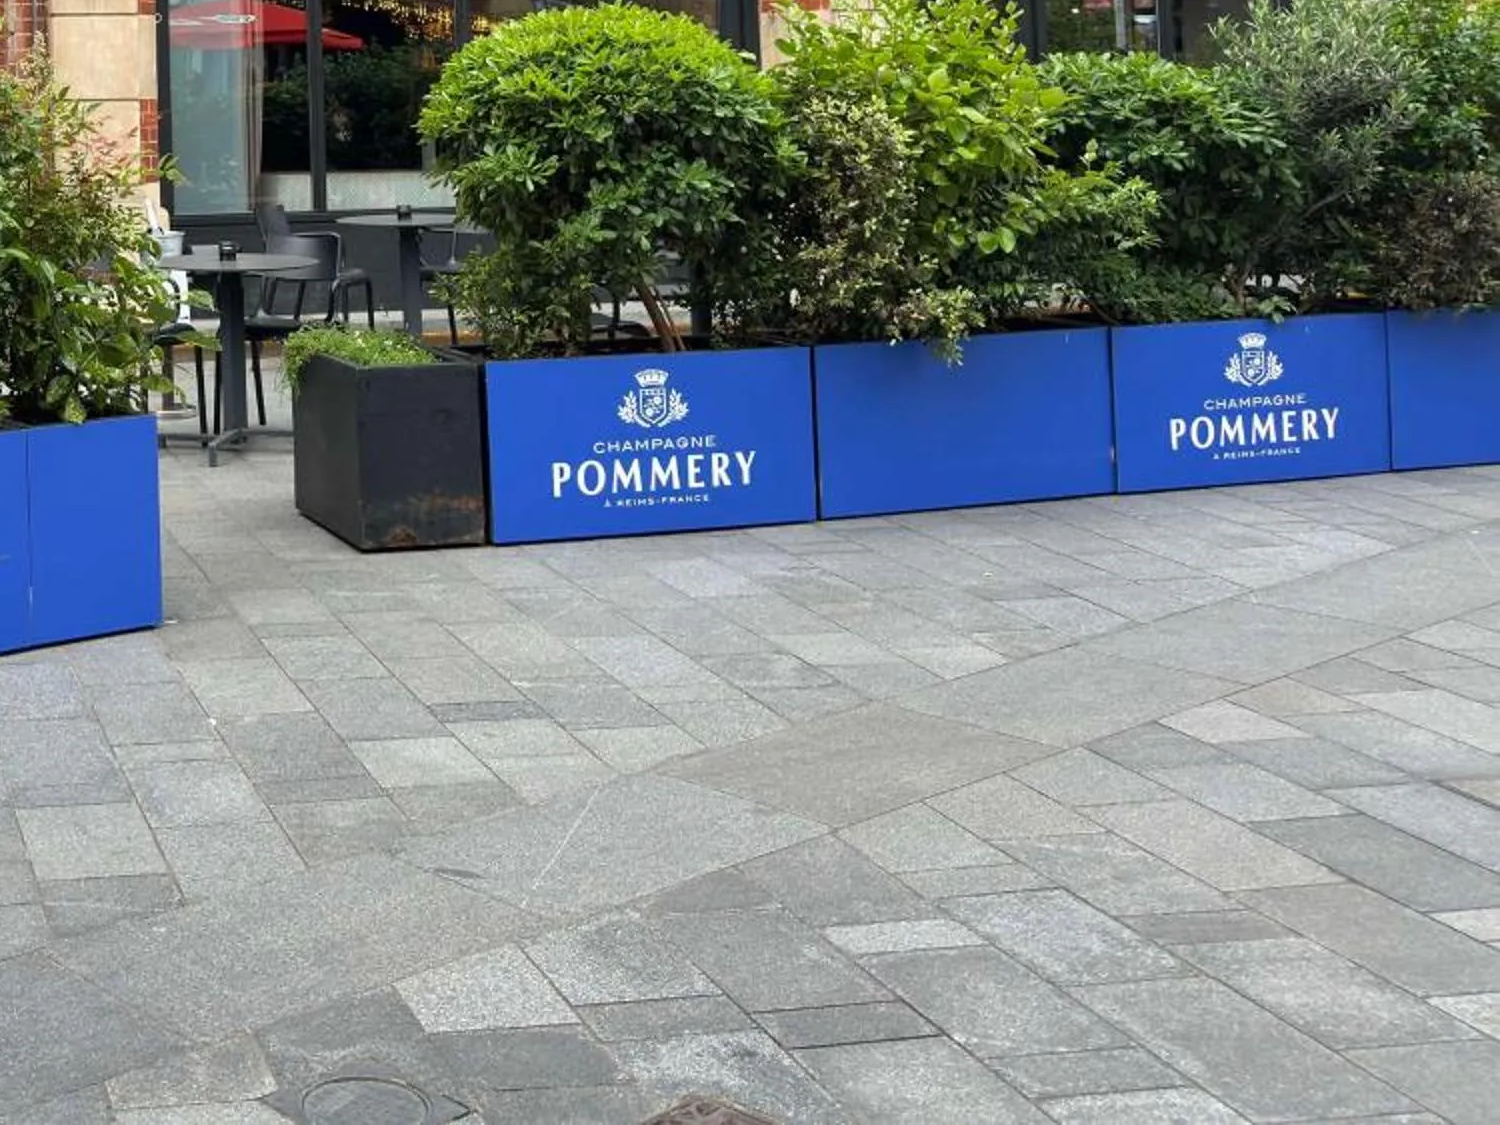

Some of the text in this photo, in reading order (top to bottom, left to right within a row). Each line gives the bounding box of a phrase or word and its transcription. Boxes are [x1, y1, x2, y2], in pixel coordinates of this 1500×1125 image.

[1203, 393, 1306, 410] CHAMPAGNE
[593, 434, 717, 454] CHAMPAGNE
[1169, 407, 1339, 452] POMMERY
[552, 451, 756, 498] POMMERY
